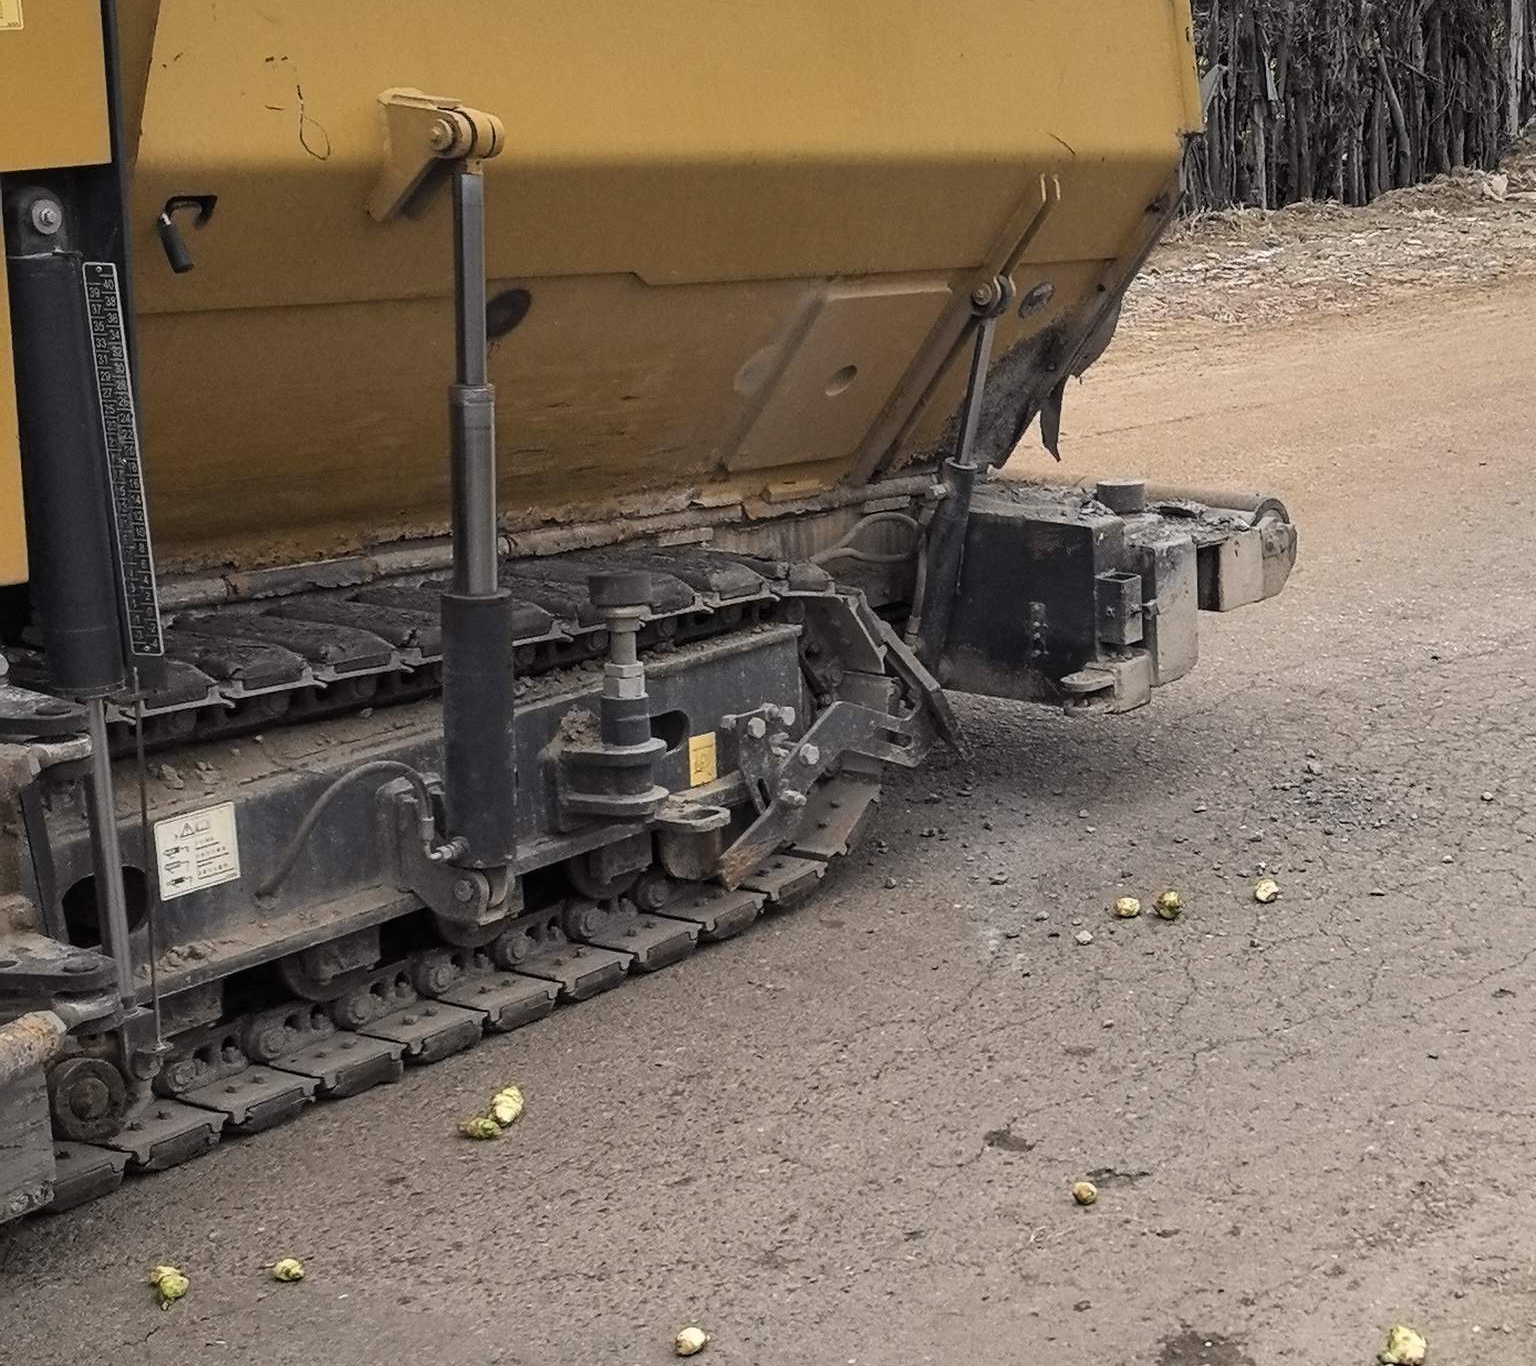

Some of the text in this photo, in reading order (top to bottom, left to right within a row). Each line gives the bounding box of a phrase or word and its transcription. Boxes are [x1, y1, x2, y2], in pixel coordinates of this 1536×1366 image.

[89, 287, 100, 298] 39
[91, 304, 102, 315] 37
[93, 321, 104, 331] 35
[96, 338, 107, 348] 33
[97, 354, 108, 364] 31
